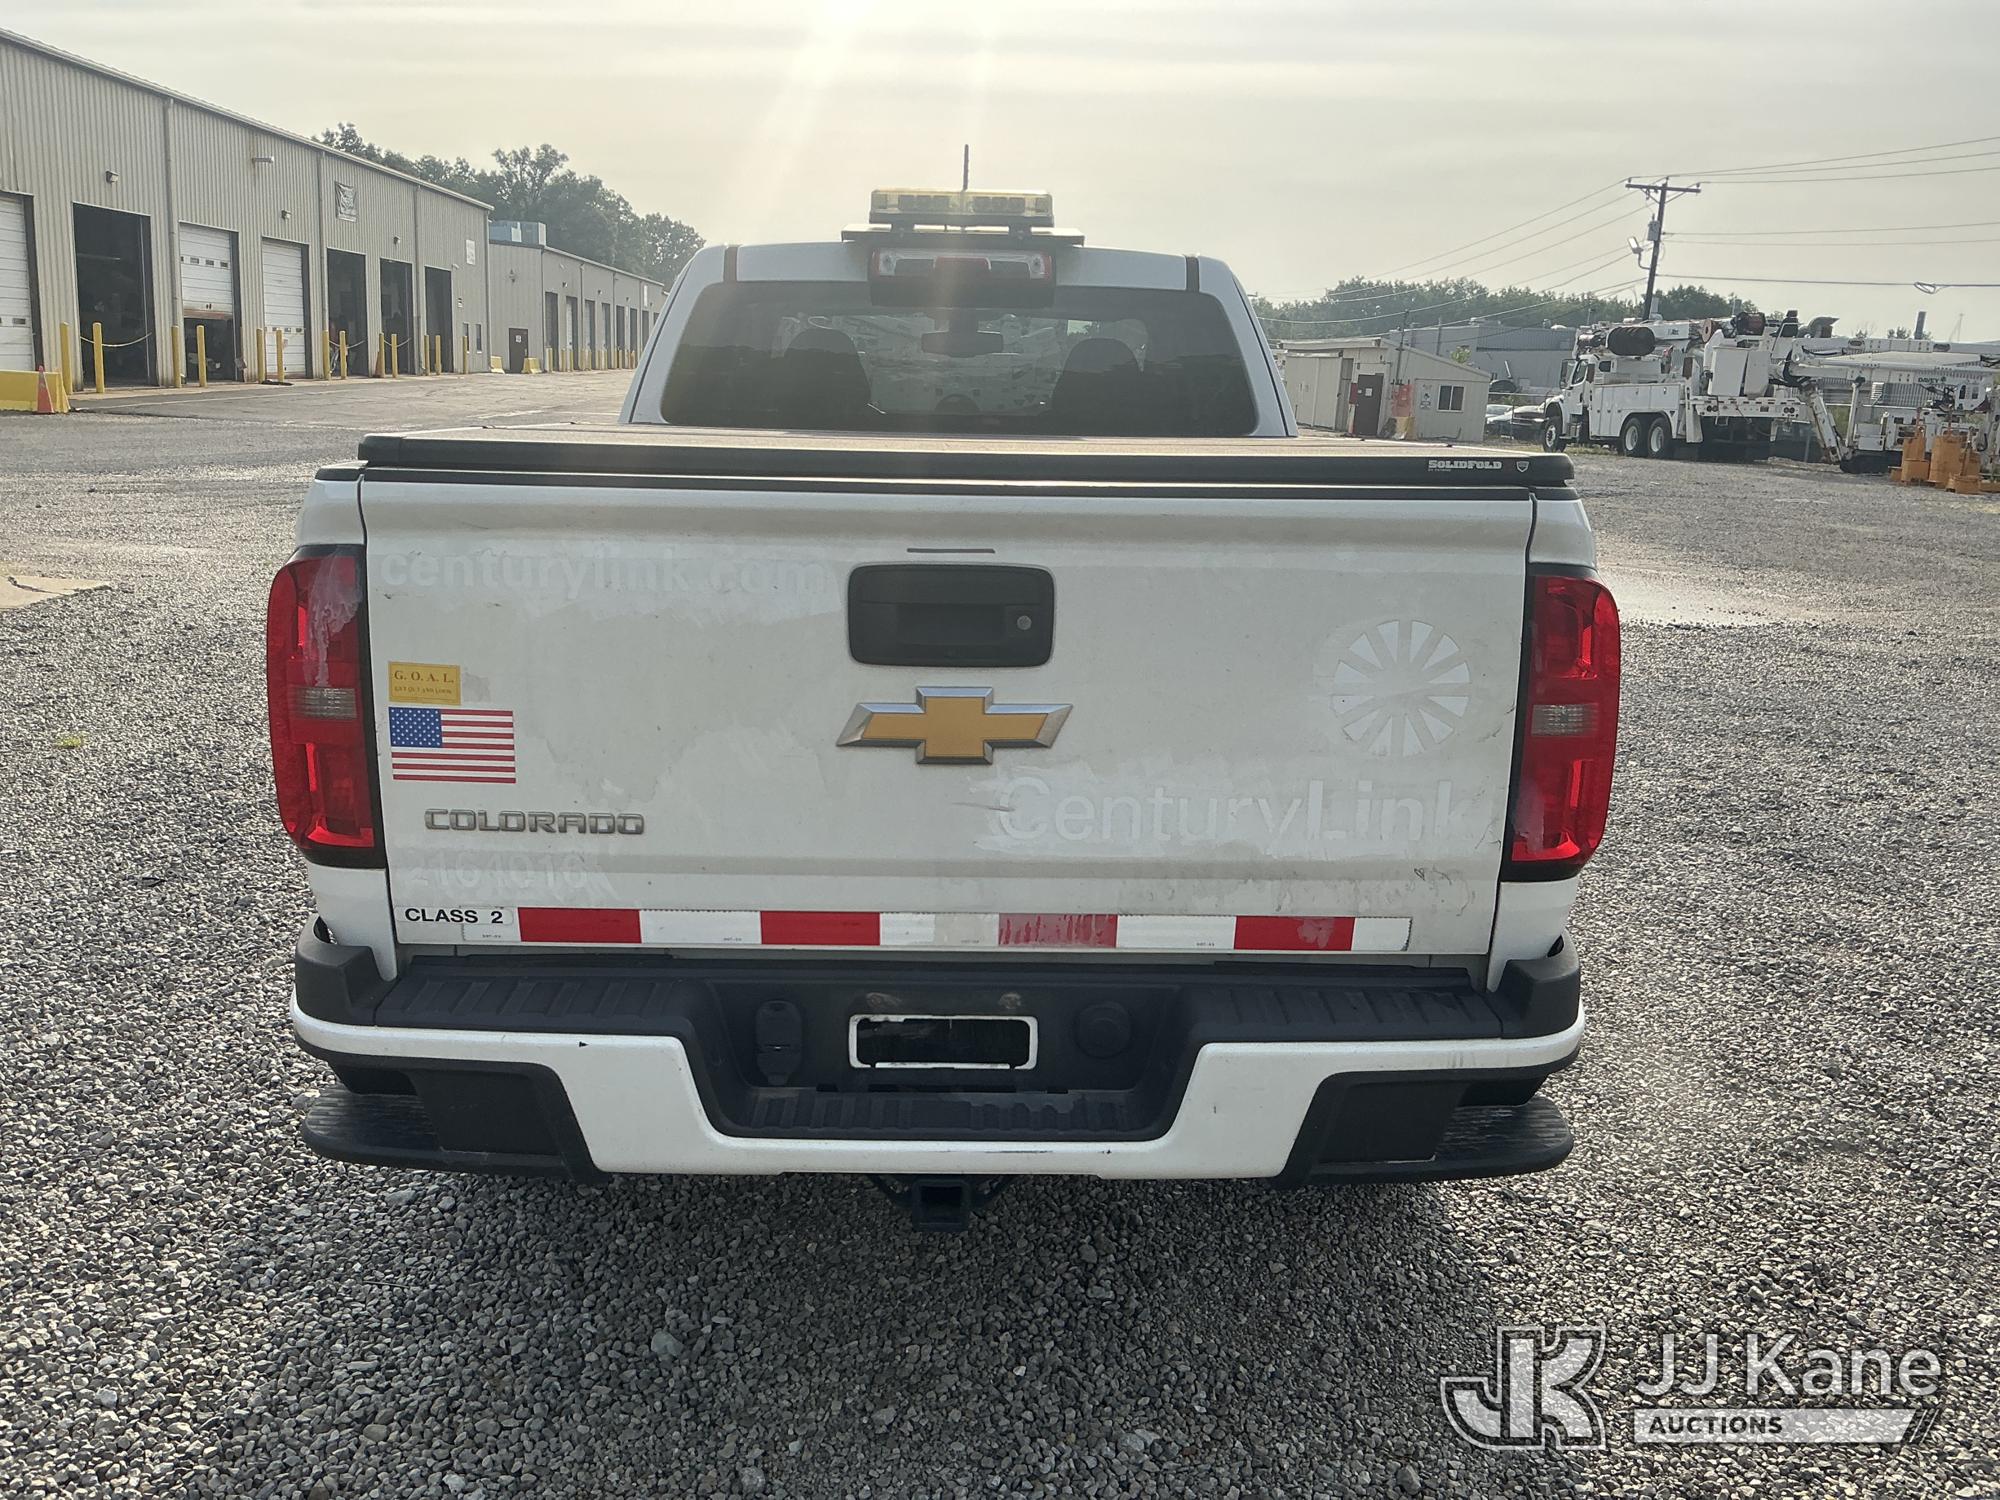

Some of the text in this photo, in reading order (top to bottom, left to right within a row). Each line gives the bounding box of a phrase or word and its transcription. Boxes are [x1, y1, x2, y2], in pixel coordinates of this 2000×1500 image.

[424, 808, 645, 835] COLORADO
[1000, 776, 1472, 853] CenturyLink
[404, 908, 504, 924] CLASS 2
